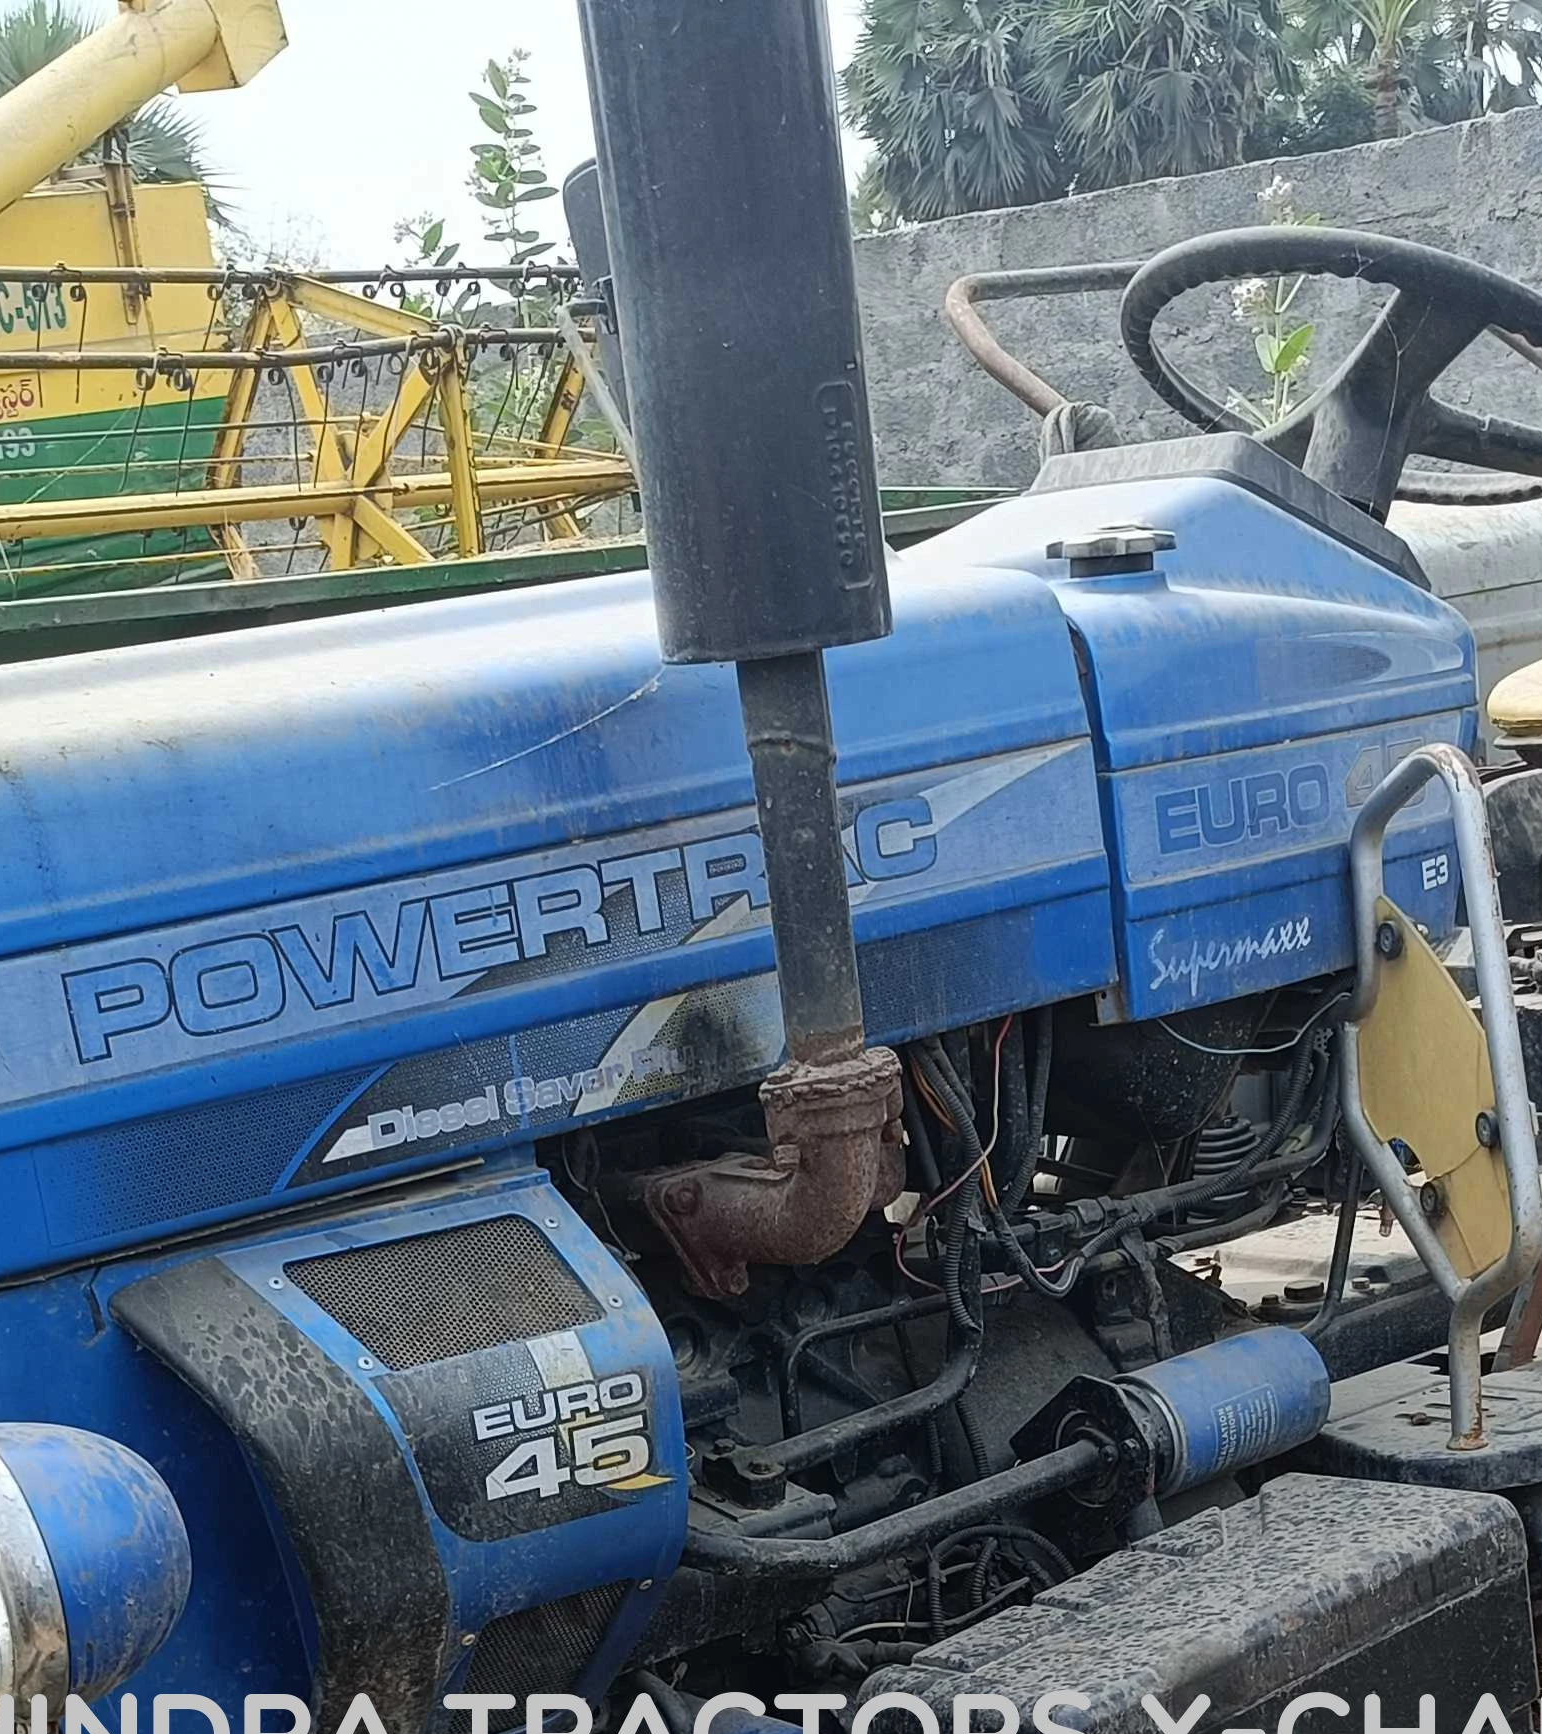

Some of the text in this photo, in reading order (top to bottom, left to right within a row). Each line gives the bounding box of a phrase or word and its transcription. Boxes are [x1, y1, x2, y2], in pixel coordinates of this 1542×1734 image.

[1155, 762, 1331, 855] EURO
[1421, 854, 1449, 891] E3
[63, 798, 939, 1066] POWERTRC
[1149, 916, 1312, 998] Supermaxx
[367, 1084, 501, 1150] Diesel
[504, 1060, 626, 1116] Saver
[472, 1372, 644, 1442] EURO
[485, 1413, 651, 1501] 45
